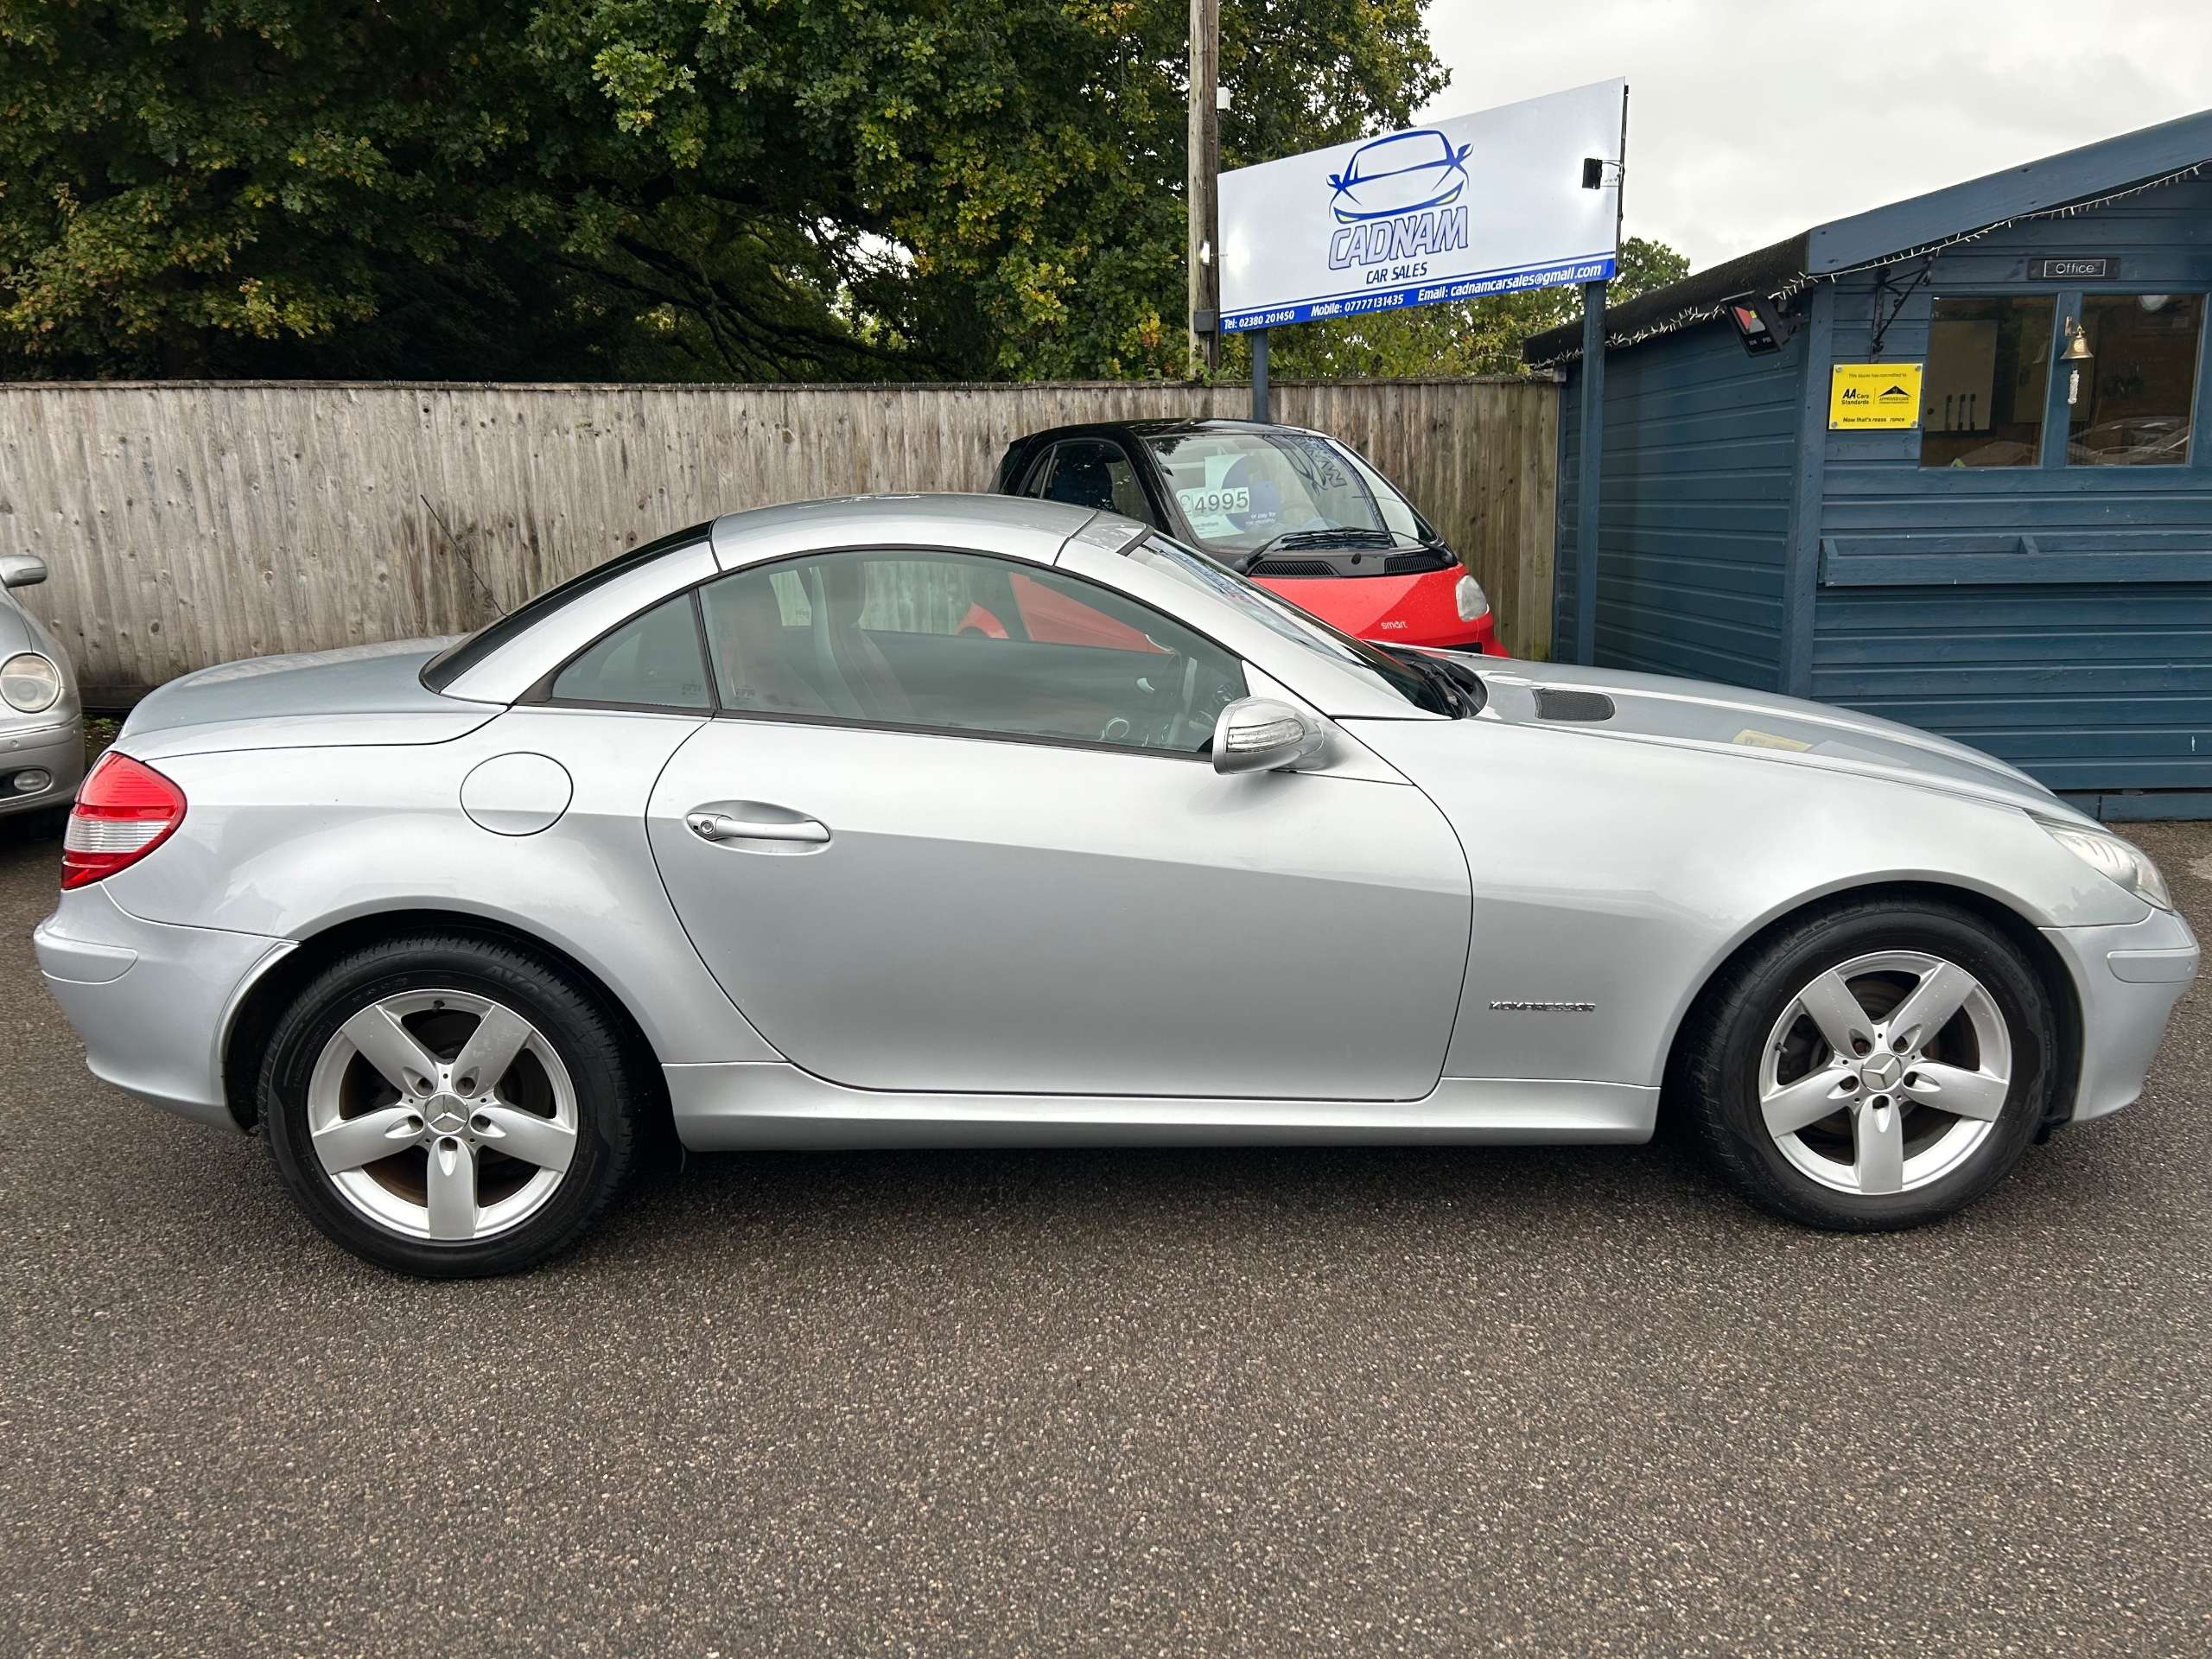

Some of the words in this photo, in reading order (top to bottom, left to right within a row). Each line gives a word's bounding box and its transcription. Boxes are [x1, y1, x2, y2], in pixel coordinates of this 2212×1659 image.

[1328, 206, 1469, 270] CADNAM
[1366, 269, 1388, 284] CAR
[1391, 262, 1427, 283] SALES
[2056, 263, 2094, 274] Office
[1417, 286, 1449, 302] Email:
[1450, 264, 1602, 297] cadnamcarsales@gmail.com
[1310, 305, 1343, 317] Mobile:
[1344, 294, 1404, 312] 07777131435
[1224, 319, 1237, 330] Tel:
[1238, 315, 1263, 327] 02380
[1265, 310, 1295, 324] 201450
[1842, 388, 1857, 399] AA
[1179, 490, 1249, 514] £4995
[1381, 620, 1408, 630] smart
[1489, 1001, 1596, 1012] KOMPRESSOR
